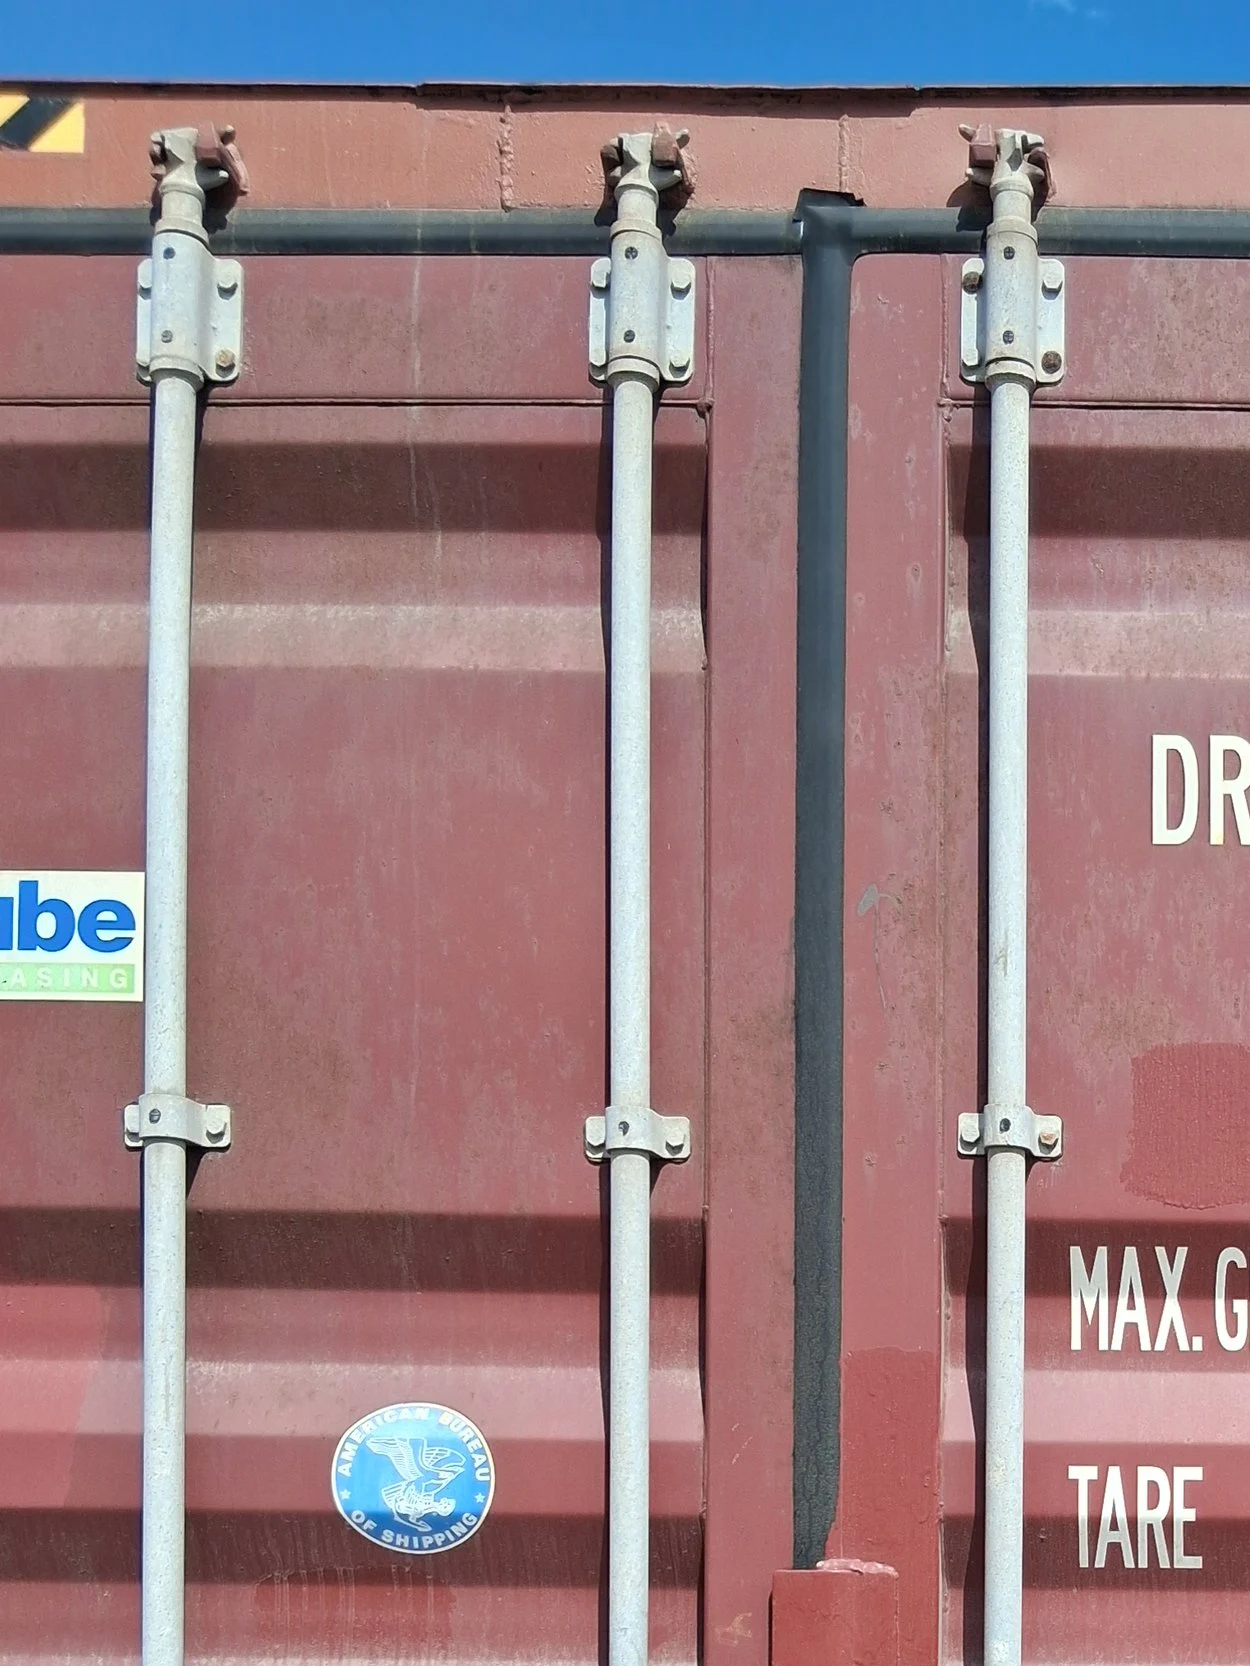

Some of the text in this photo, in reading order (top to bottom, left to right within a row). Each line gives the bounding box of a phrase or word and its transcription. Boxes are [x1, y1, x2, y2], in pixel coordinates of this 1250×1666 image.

[1069, 1246, 1203, 1352] MAX.
[337, 1407, 491, 1481] AMERICAN BUREAU
[350, 1510, 479, 1549] OF SHIPPING
[1068, 1464, 1203, 1569] TARE
